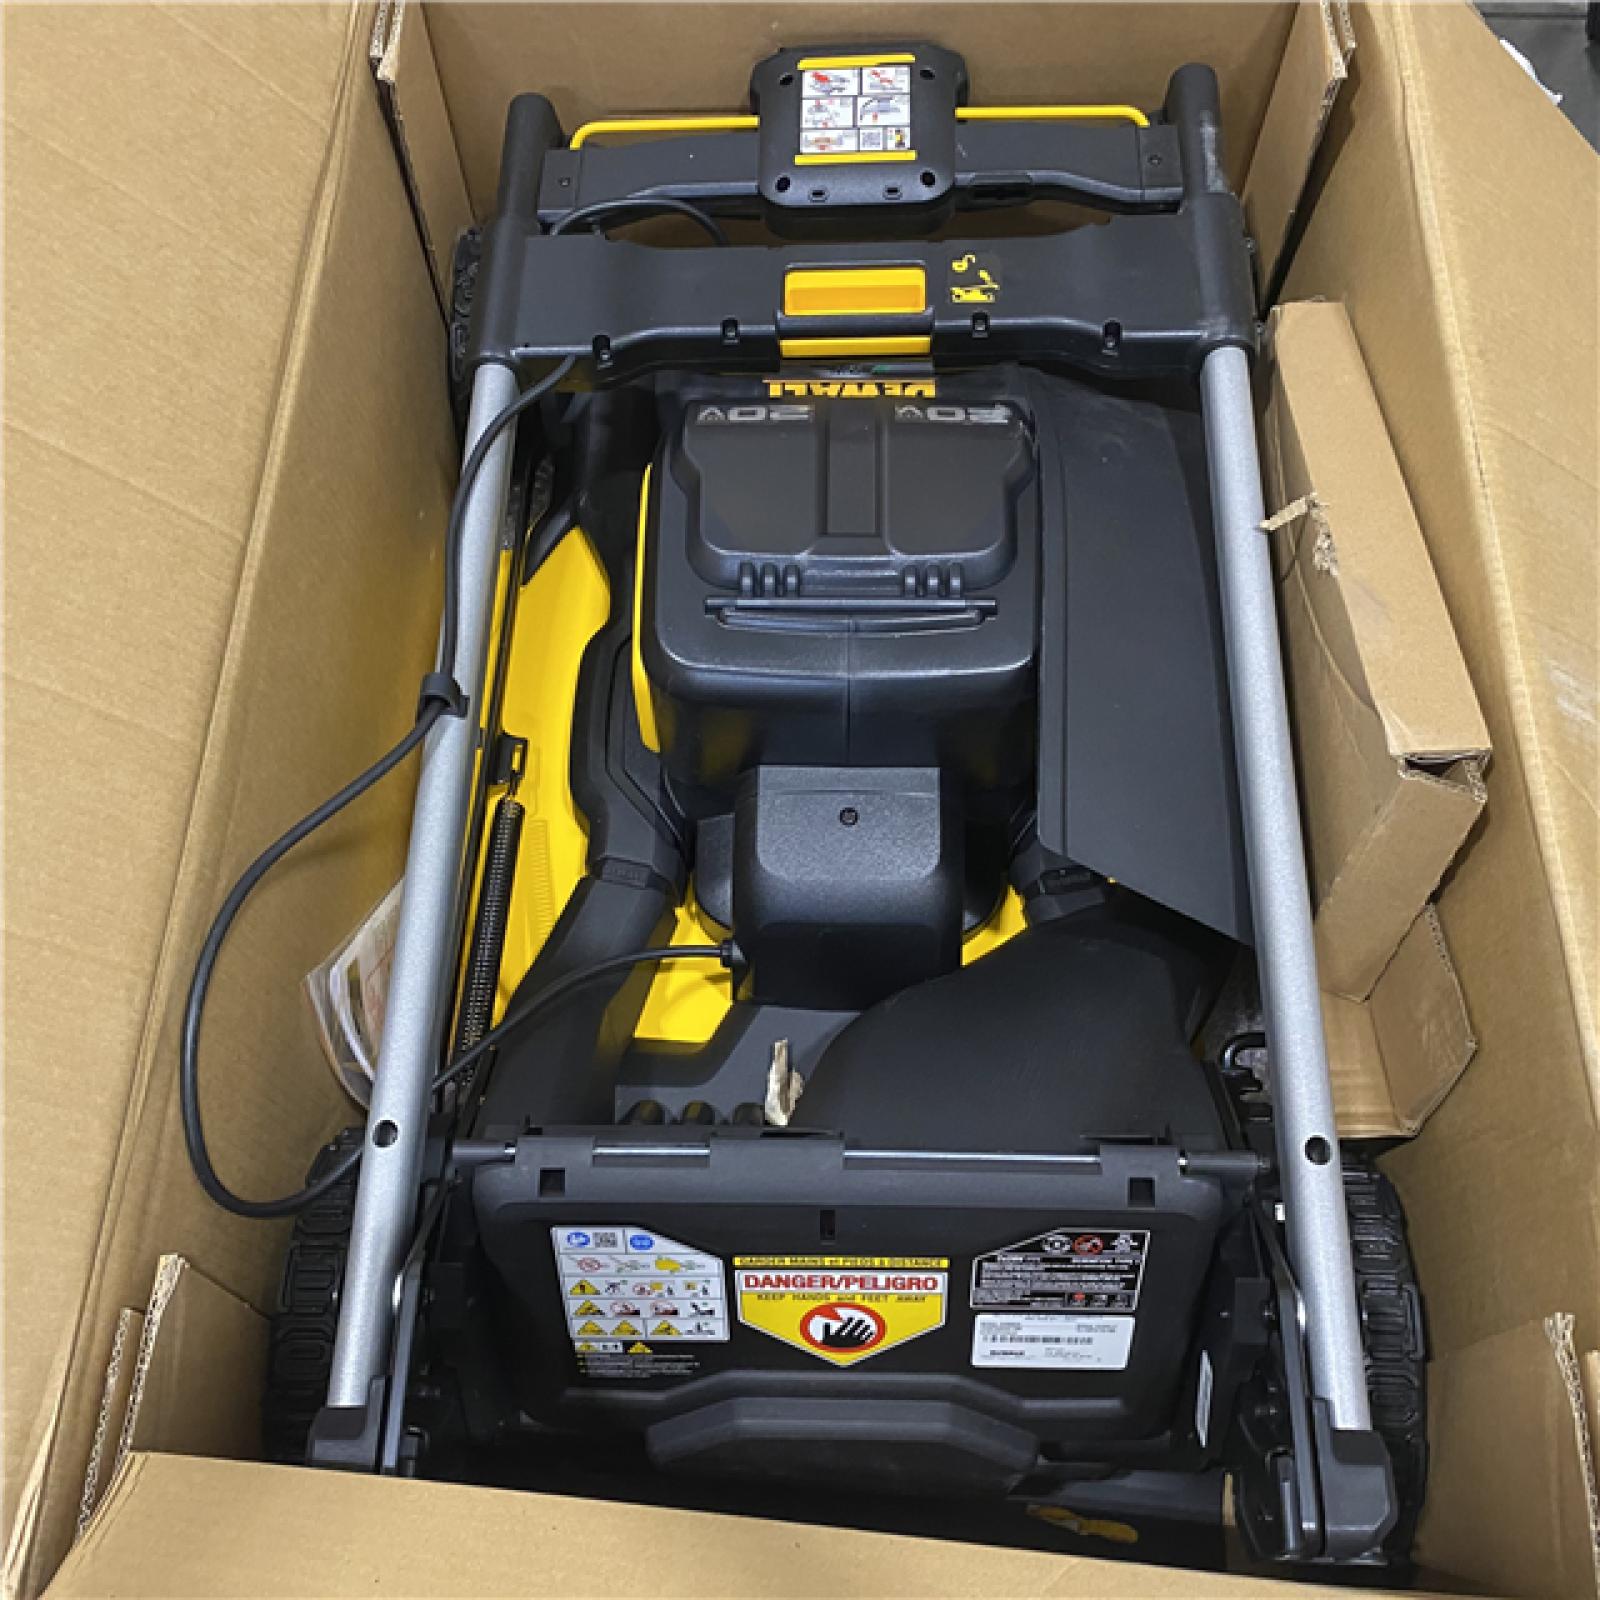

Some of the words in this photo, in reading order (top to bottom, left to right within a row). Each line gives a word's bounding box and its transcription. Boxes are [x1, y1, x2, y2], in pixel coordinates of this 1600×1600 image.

[744, 1274, 938, 1290] DANGER/PELIGRO
[757, 1293, 785, 1301] KEEP
[792, 1293, 831, 1301] HANDS
[862, 1293, 888, 1302] FEET
[896, 1294, 926, 1302] AWAY
